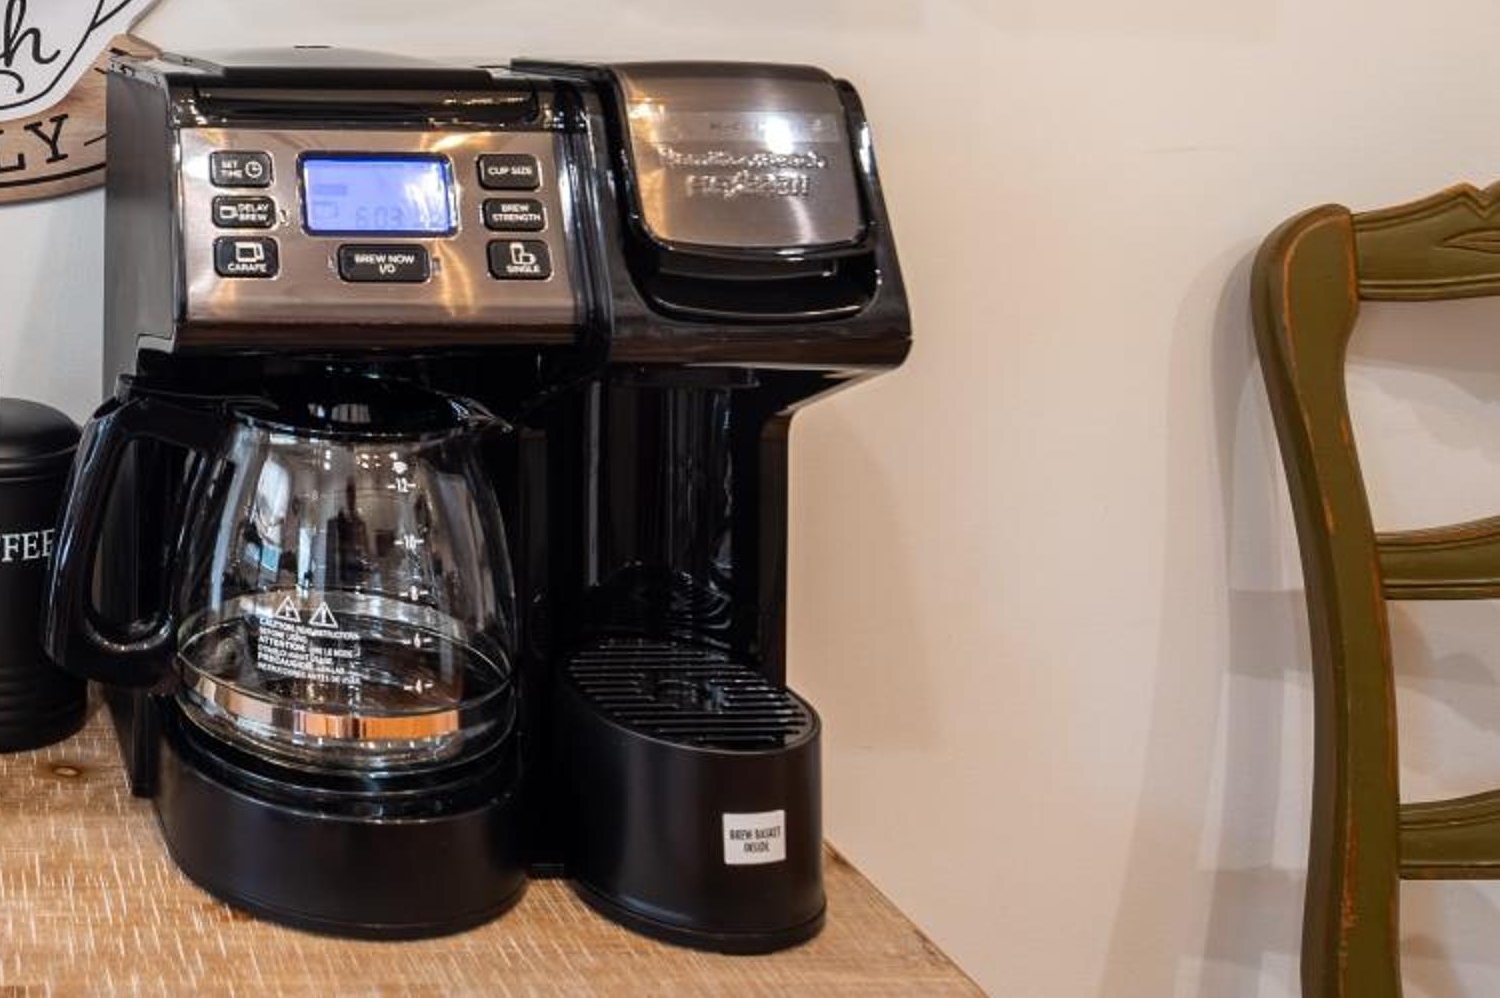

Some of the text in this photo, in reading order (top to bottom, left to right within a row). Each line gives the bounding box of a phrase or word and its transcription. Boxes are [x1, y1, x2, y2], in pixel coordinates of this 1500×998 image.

[238, 203, 268, 212] DELAY
[501, 204, 529, 213] BREW
[239, 213, 268, 221] BREW
[492, 213, 540, 221] STRENGTH
[355, 254, 414, 264] BREW NOW
[227, 262, 267, 273] CARAFE
[505, 264, 541, 273] SINGLE
[729, 829, 753, 841] BREW
